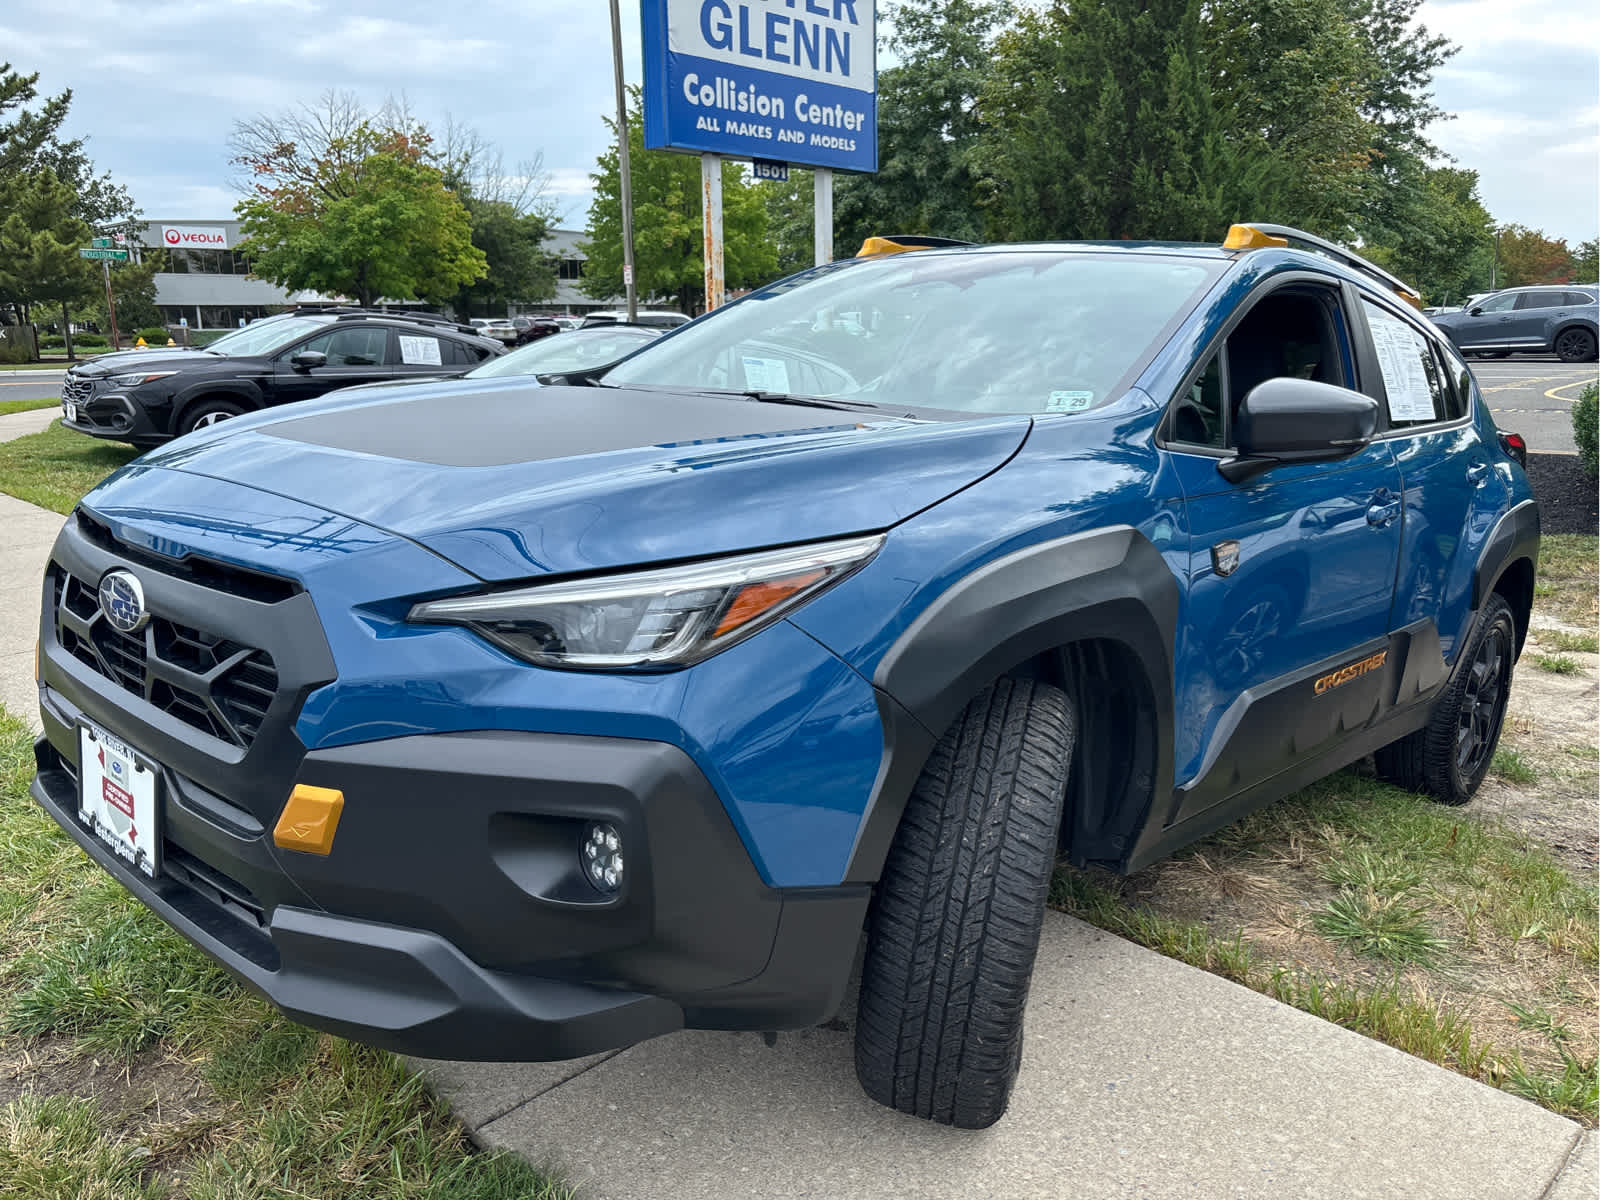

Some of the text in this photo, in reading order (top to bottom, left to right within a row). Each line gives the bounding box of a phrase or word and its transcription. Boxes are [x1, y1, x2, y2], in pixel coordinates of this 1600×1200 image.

[700, 0, 850, 77] GLENN
[683, 73, 865, 132] Collision Center
[697, 116, 856, 152] ALL MAKES AND MODELS
[756, 163, 787, 179] 1501
[182, 232, 225, 243] VEOLIA
[1071, 398, 1087, 407] 29
[1314, 651, 1387, 694] CROSSTREK
